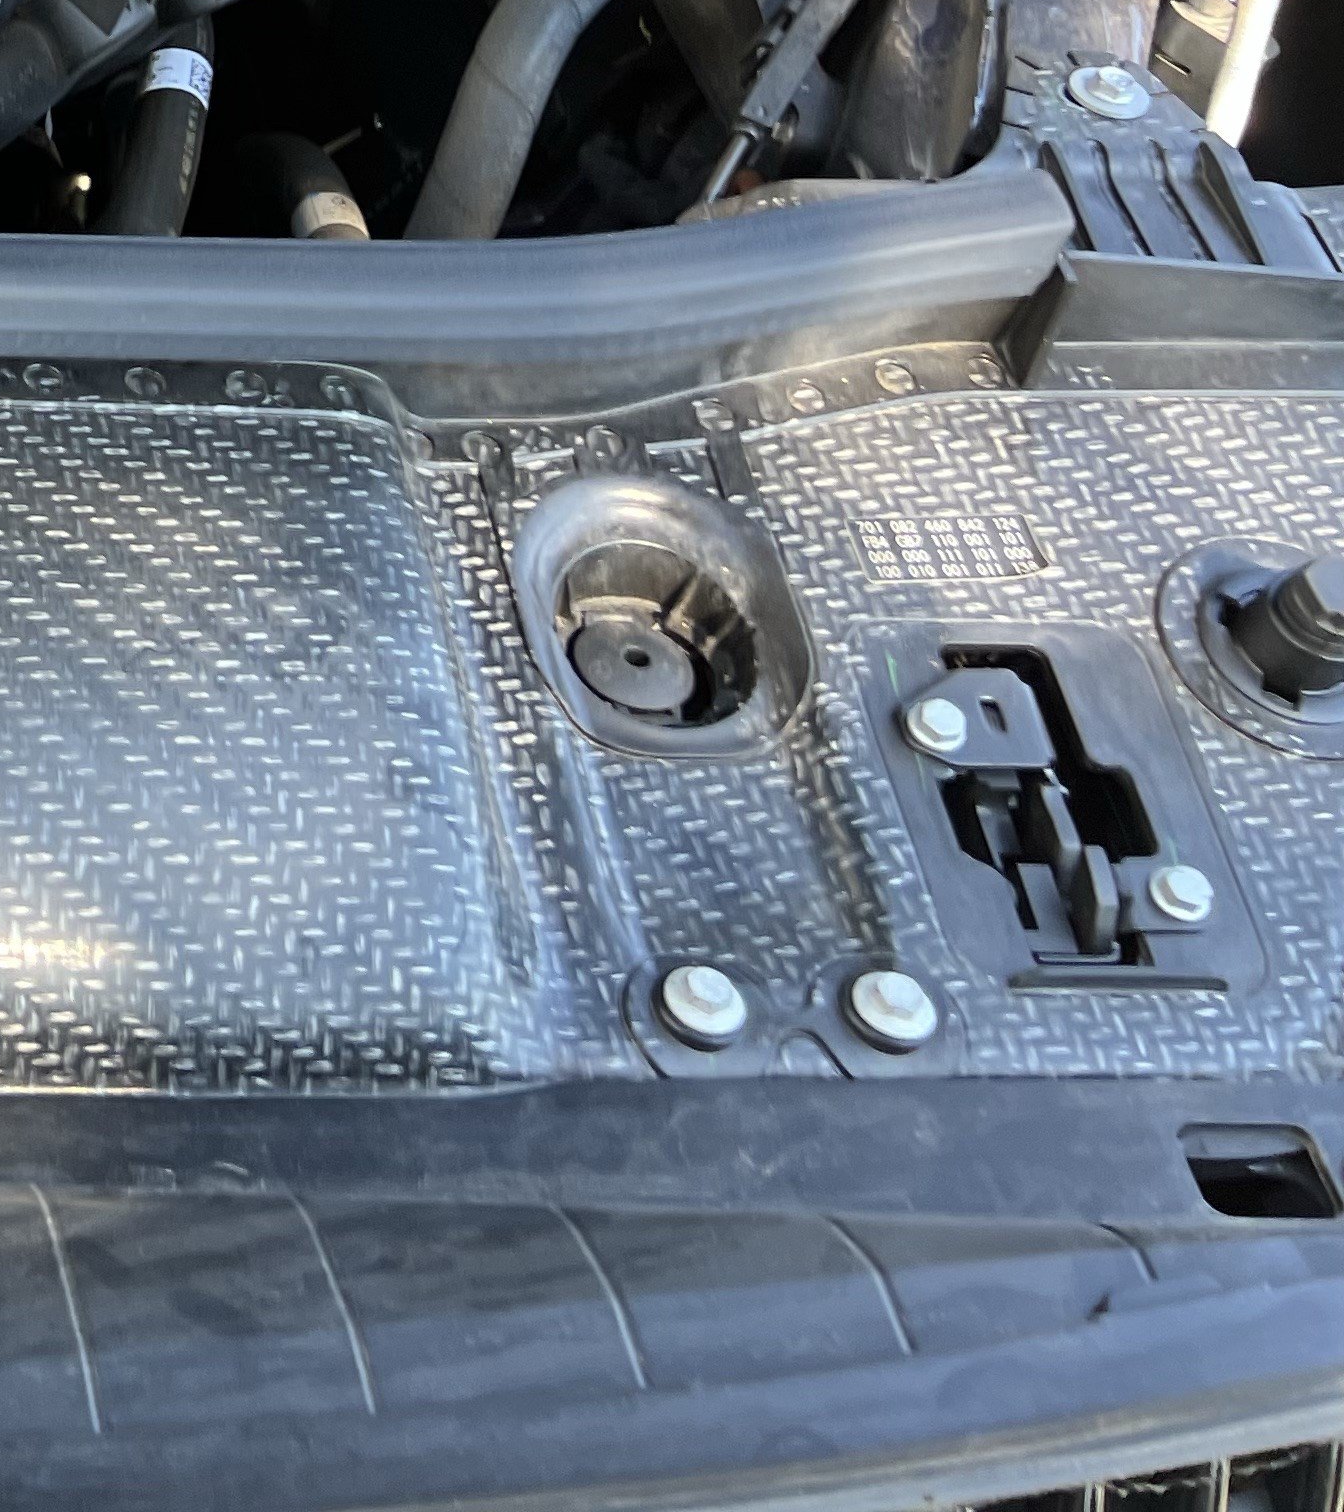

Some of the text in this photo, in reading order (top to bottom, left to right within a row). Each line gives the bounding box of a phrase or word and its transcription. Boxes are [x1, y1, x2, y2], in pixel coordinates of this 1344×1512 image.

[855, 520, 884, 534] 701
[930, 533, 960, 546] 110
[961, 532, 991, 545] 001
[998, 531, 1025, 544] 101
[866, 545, 1034, 564] 000 000 111 101 000
[875, 565, 903, 579] 100
[906, 564, 938, 577] 010
[940, 563, 970, 576] 001
[974, 561, 1004, 575] 011
